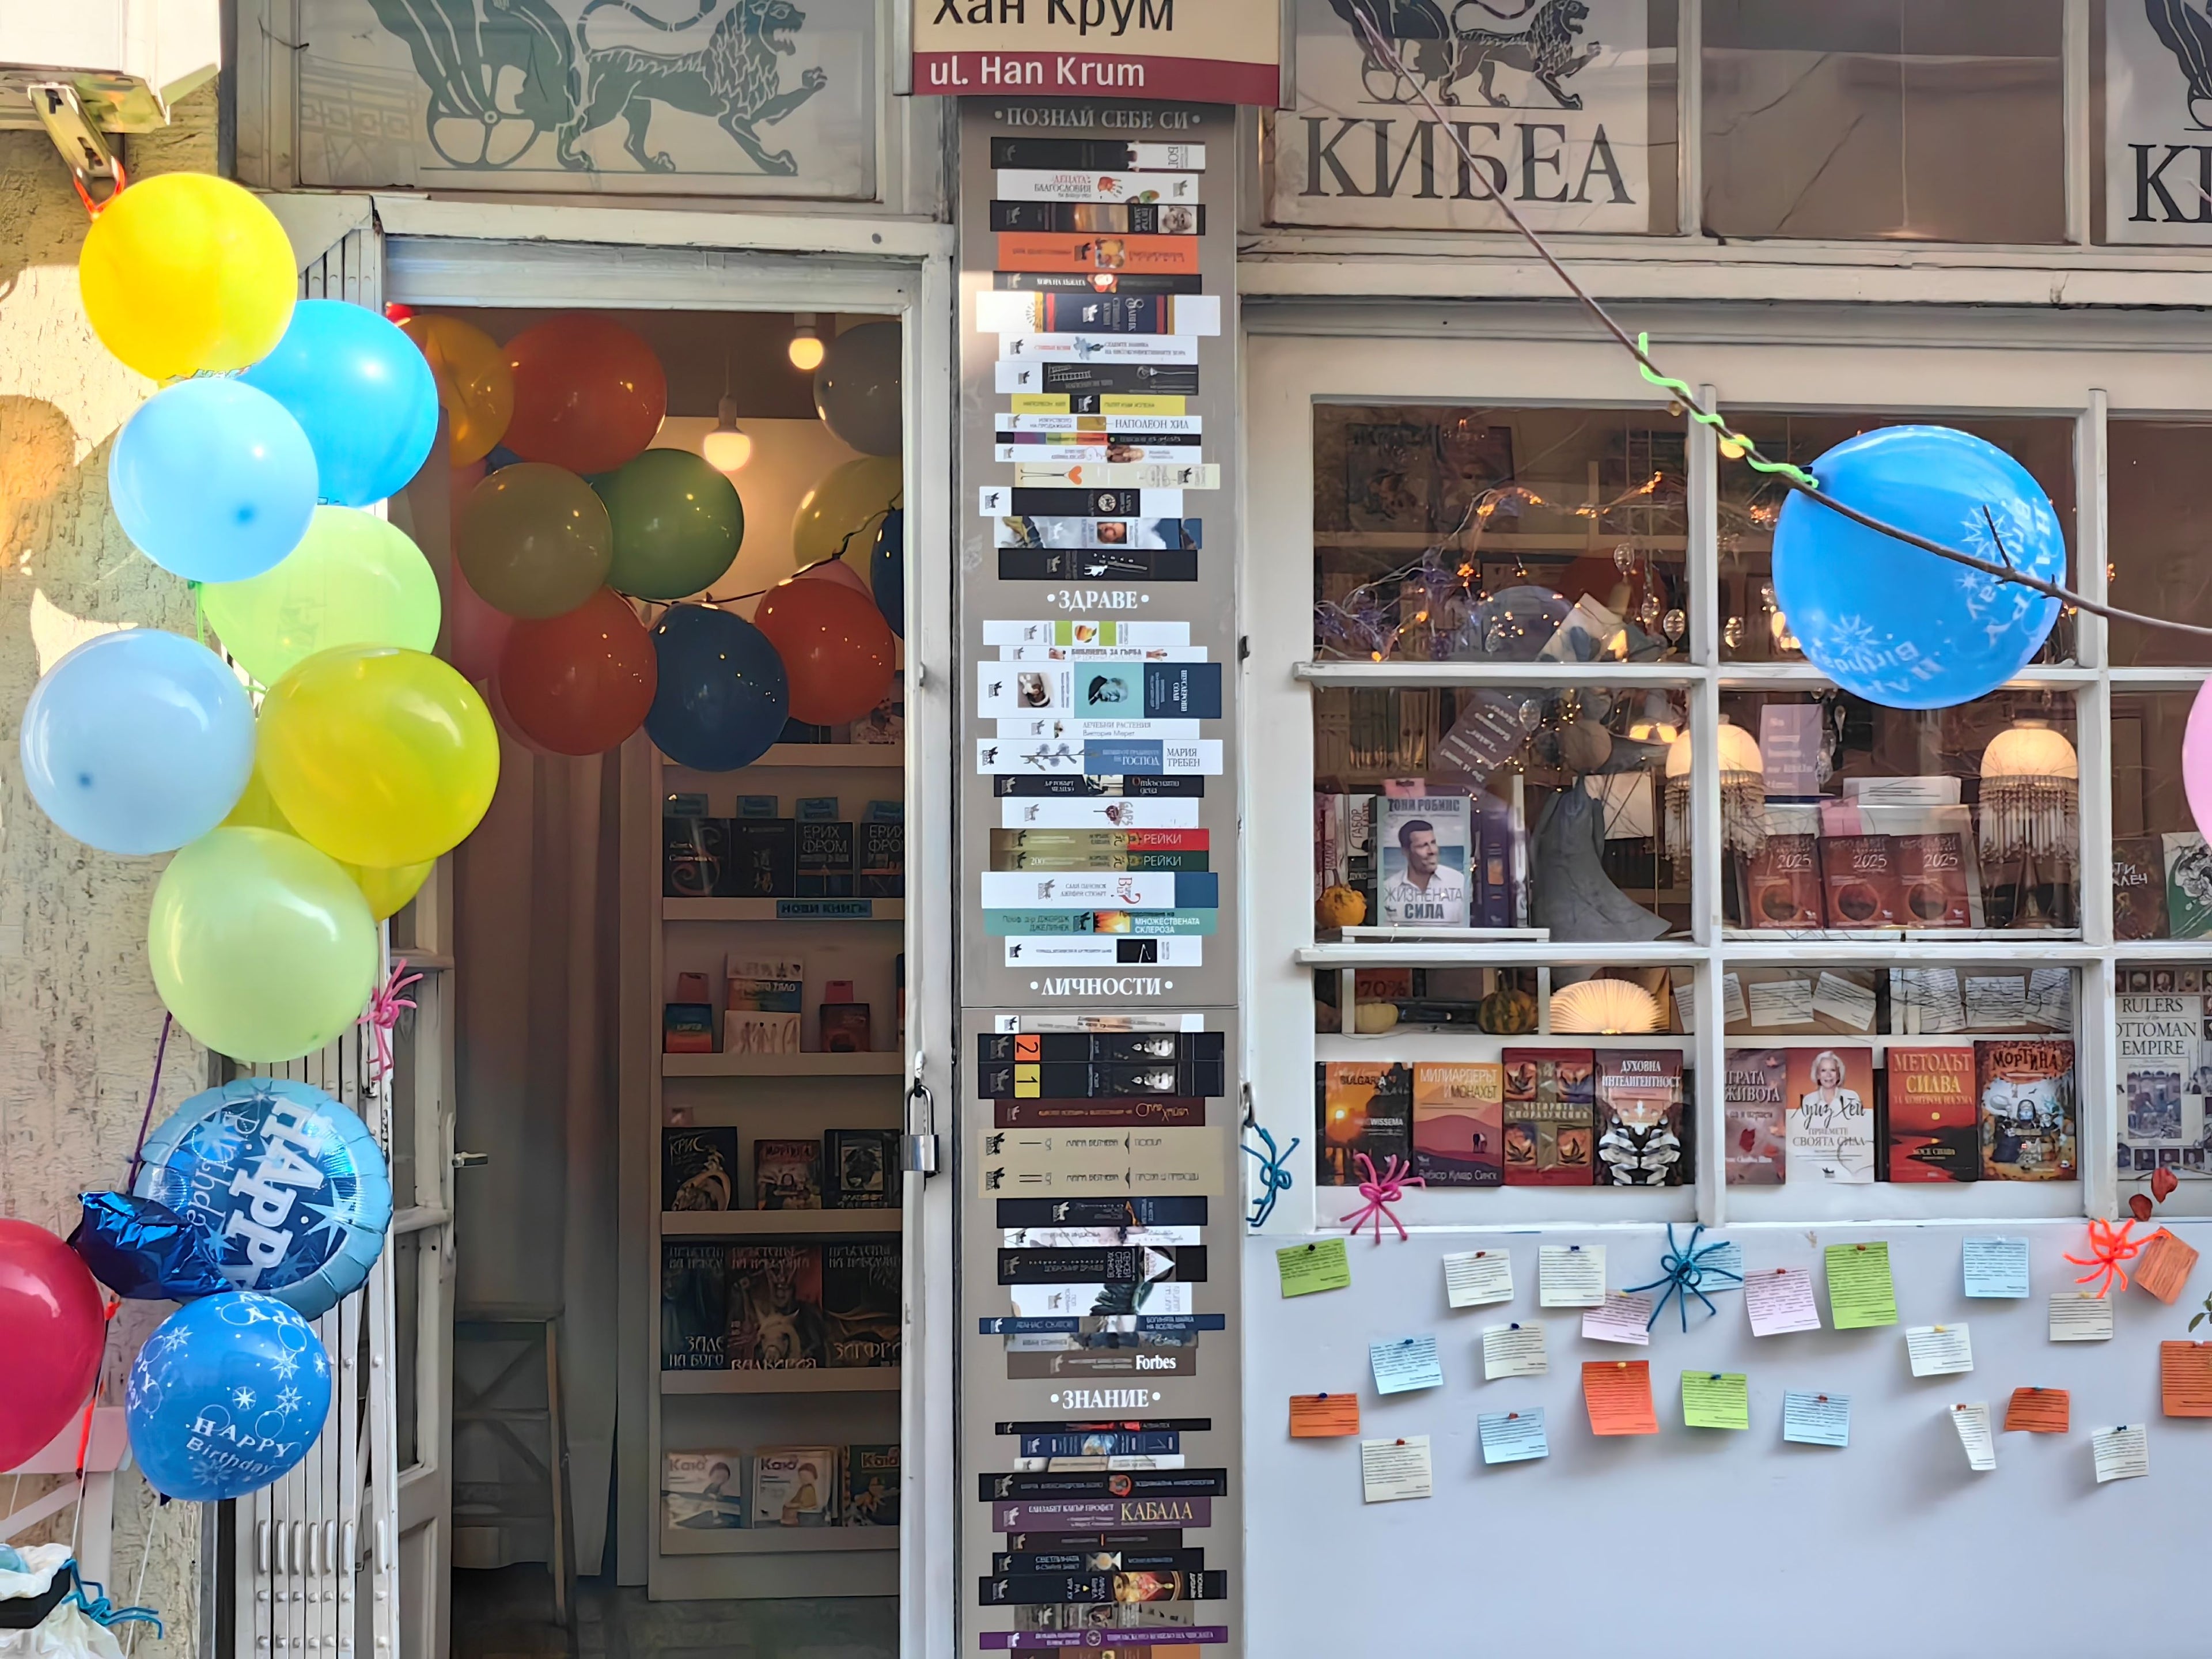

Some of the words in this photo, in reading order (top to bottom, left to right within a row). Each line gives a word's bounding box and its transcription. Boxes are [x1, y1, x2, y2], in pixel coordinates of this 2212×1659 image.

[930, 58, 968, 86] ul.
[980, 56, 1043, 85] Han
[1056, 56, 1145, 86] Krum
[1006, 105, 1094, 128] ПОЗНАЙ
[1101, 109, 1153, 129] СЕБЕ
[1160, 110, 1188, 130] СИ
[1298, 116, 1637, 204] КИБЕА
[1115, 420, 1167, 429] НАПОЛЕОН
[1170, 421, 1189, 429] ХИЛ
[1058, 590, 1138, 612] ЗДРАВЕ
[1166, 748, 1197, 756] МАРИЯ
[1122, 756, 1160, 766] ГОСПОД
[1166, 758, 1200, 767] ТРЕБЕН
[1418, 798, 1460, 812] РОБИНС
[1351, 808, 1363, 839] ГАБОР
[804, 825, 840, 838] ЕРИХ
[1143, 833, 1181, 844] РЕЙКИ
[802, 839, 847, 854] ФРОМ
[868, 839, 903, 853] ФРО
[1143, 855, 1181, 866] РЕЙКИ
[1777, 853, 1812, 869] 2025
[1853, 854, 1887, 869] 2025
[1923, 853, 1958, 869] 2025
[1384, 886, 1463, 903] ЖИЗНЕНАТА
[781, 904, 819, 913] НОВИ
[823, 904, 868, 913] КНИГИ
[1404, 903, 1445, 919] СИЛА
[1041, 978, 1161, 995] ЛИЧНОСТИ
[2123, 998, 2183, 1013] RULERS
[2122, 1040, 2184, 1055] EMPIRE
[1620, 1060, 1661, 1074] ДУХОВНА
[1893, 1053, 1971, 1073] МЕТОДЪТ
[1992, 1050, 2059, 1072] МОРТИНА
[1419, 1068, 1497, 1084] МИЛИАРДЕРЪТ
[1601, 1075, 1681, 1089] ИНТЕЛИГЕНТНОСТ
[1451, 1085, 1496, 1099] МОНАХЪТ
[1906, 1075, 1961, 1094] СИЛВА
[1791, 1094, 1831, 1130] Луиз
[1831, 1096, 1866, 1119] Хей
[1792, 1137, 1835, 1147] СВОЯТА
[1136, 1355, 1176, 1370] Forbes
[1063, 1389, 1149, 1409] ЗНАНИЕ
[191, 1414, 295, 1459] HAPPY
[186, 1436, 276, 1478] Birthday
[1120, 1502, 1193, 1520] КАБАЛА
